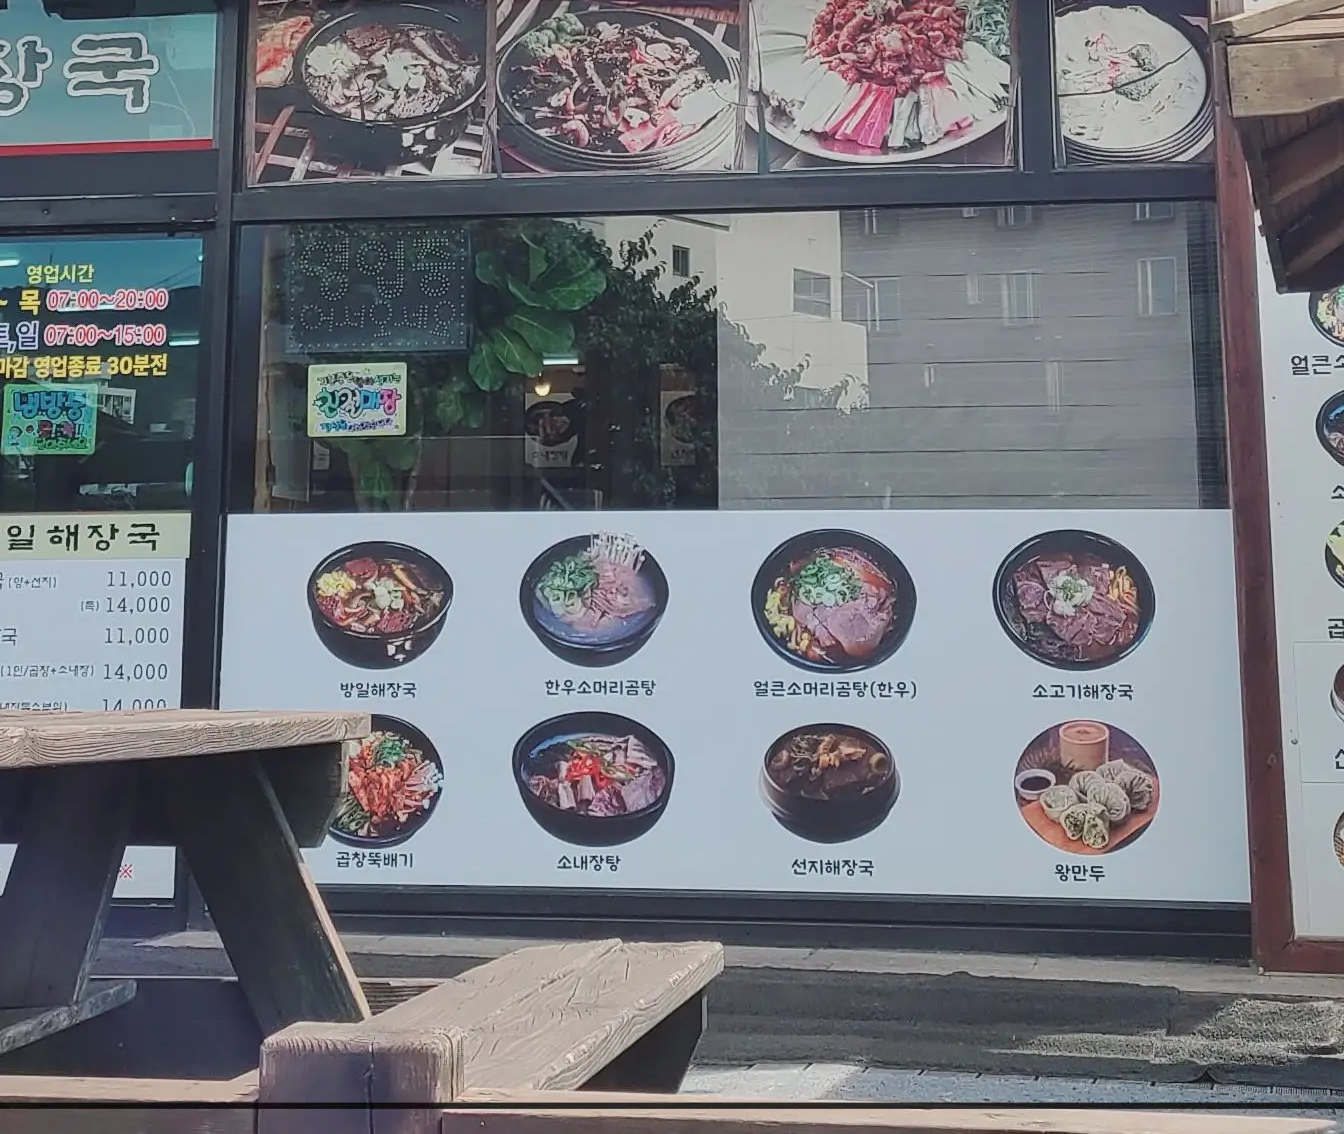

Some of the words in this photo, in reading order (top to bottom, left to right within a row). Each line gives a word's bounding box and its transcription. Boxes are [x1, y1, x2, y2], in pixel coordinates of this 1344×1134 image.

[27, 264, 95, 284] 영업시간
[19, 289, 41, 316] 목
[46, 289, 169, 312] 07:00~20:00
[43, 323, 167, 347] 07:00~15:00
[33, 354, 102, 379] 영업종료
[106, 353, 168, 377] 30분전
[106, 570, 171, 589] 11,000
[105, 596, 170, 615] 14,000
[104, 627, 169, 646] 11,000
[102, 663, 168, 682] 14,000
[339, 681, 418, 699] 방일해장국
[544, 678, 657, 697] 한우소머리곰탕
[753, 680, 918, 700] 얼큰소머리곰탕(한우)
[1032, 684, 1134, 702] 소고기해장국
[336, 851, 414, 869] 곱창뚝배기
[557, 854, 622, 873] 소내장탕
[791, 858, 875, 878] 선지해장국
[1054, 864, 1106, 883] 왕만두
